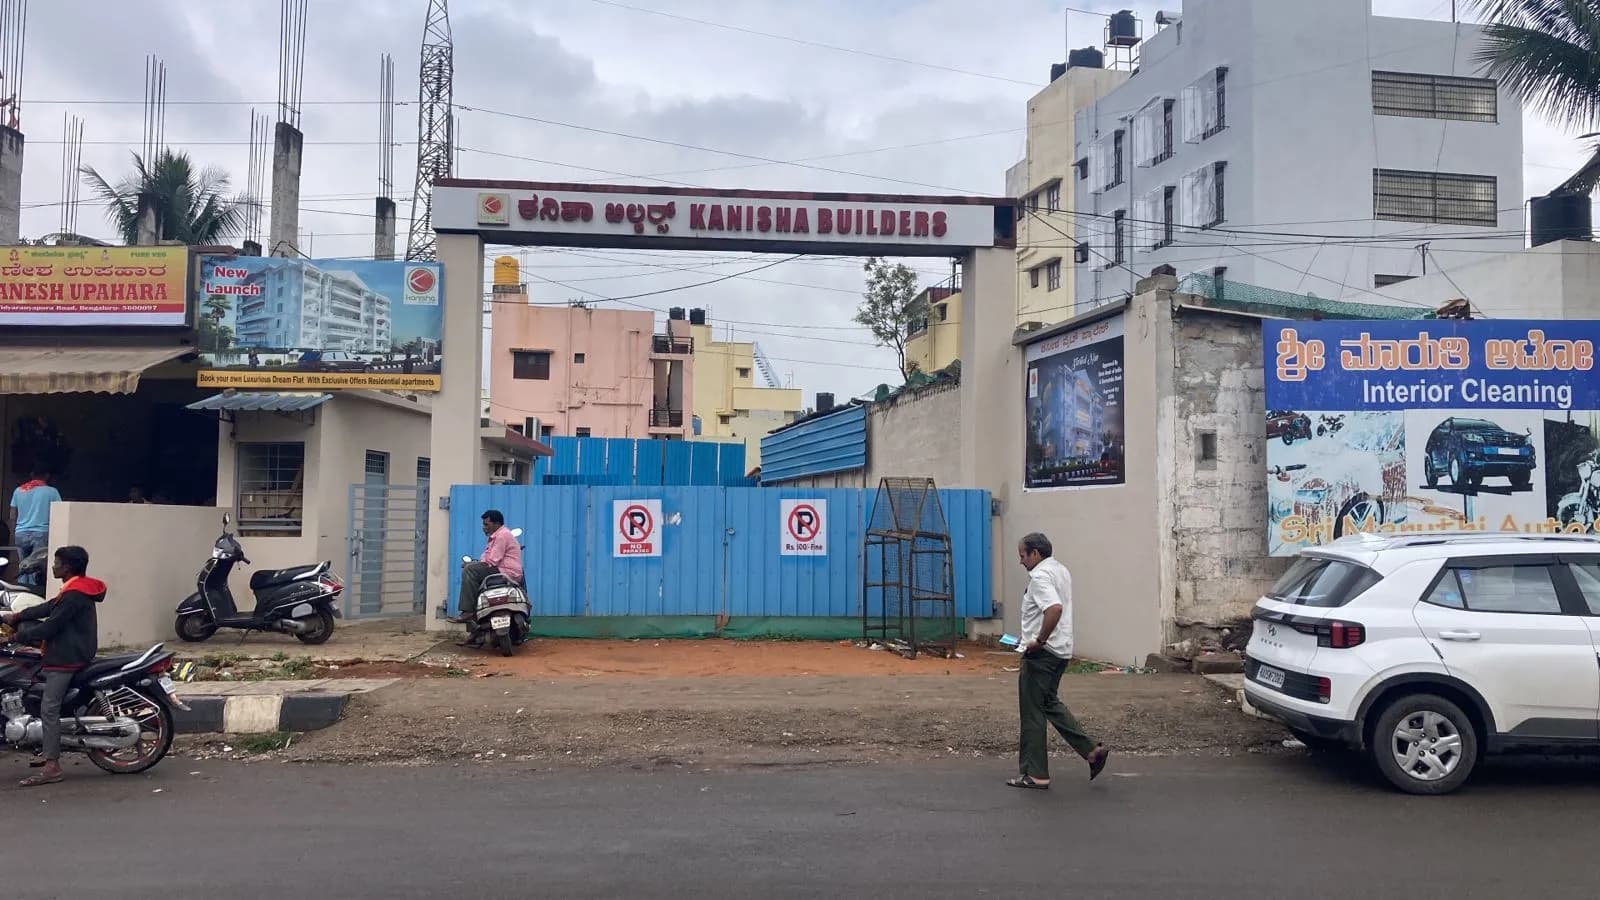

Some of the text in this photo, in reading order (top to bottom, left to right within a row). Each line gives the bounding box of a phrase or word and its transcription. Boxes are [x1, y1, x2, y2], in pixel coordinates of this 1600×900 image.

[690, 203, 948, 237] KANISHA BUILDERS
[63, 264, 167, 277] ಉಪಹಾರ
[214, 266, 248, 278] New
[69, 282, 168, 301] UPAHARA
[205, 282, 260, 295] Launch
[1276, 328, 1594, 382] ಶ್ರೀ ಮಾರುತಿ ಆಟೋ
[200, 374, 215, 382] Book
[216, 376, 229, 384] your
[243, 375, 272, 383] Luxurious
[272, 376, 291, 384] Dream
[307, 376, 321, 384] With
[321, 376, 348, 385] Exclusive
[349, 376, 367, 385] Offers
[368, 377, 401, 386] Residential
[401, 377, 434, 387] apartments
[1362, 378, 1572, 408] Interior Cleaning
[1280, 514, 1333, 545] Sri
